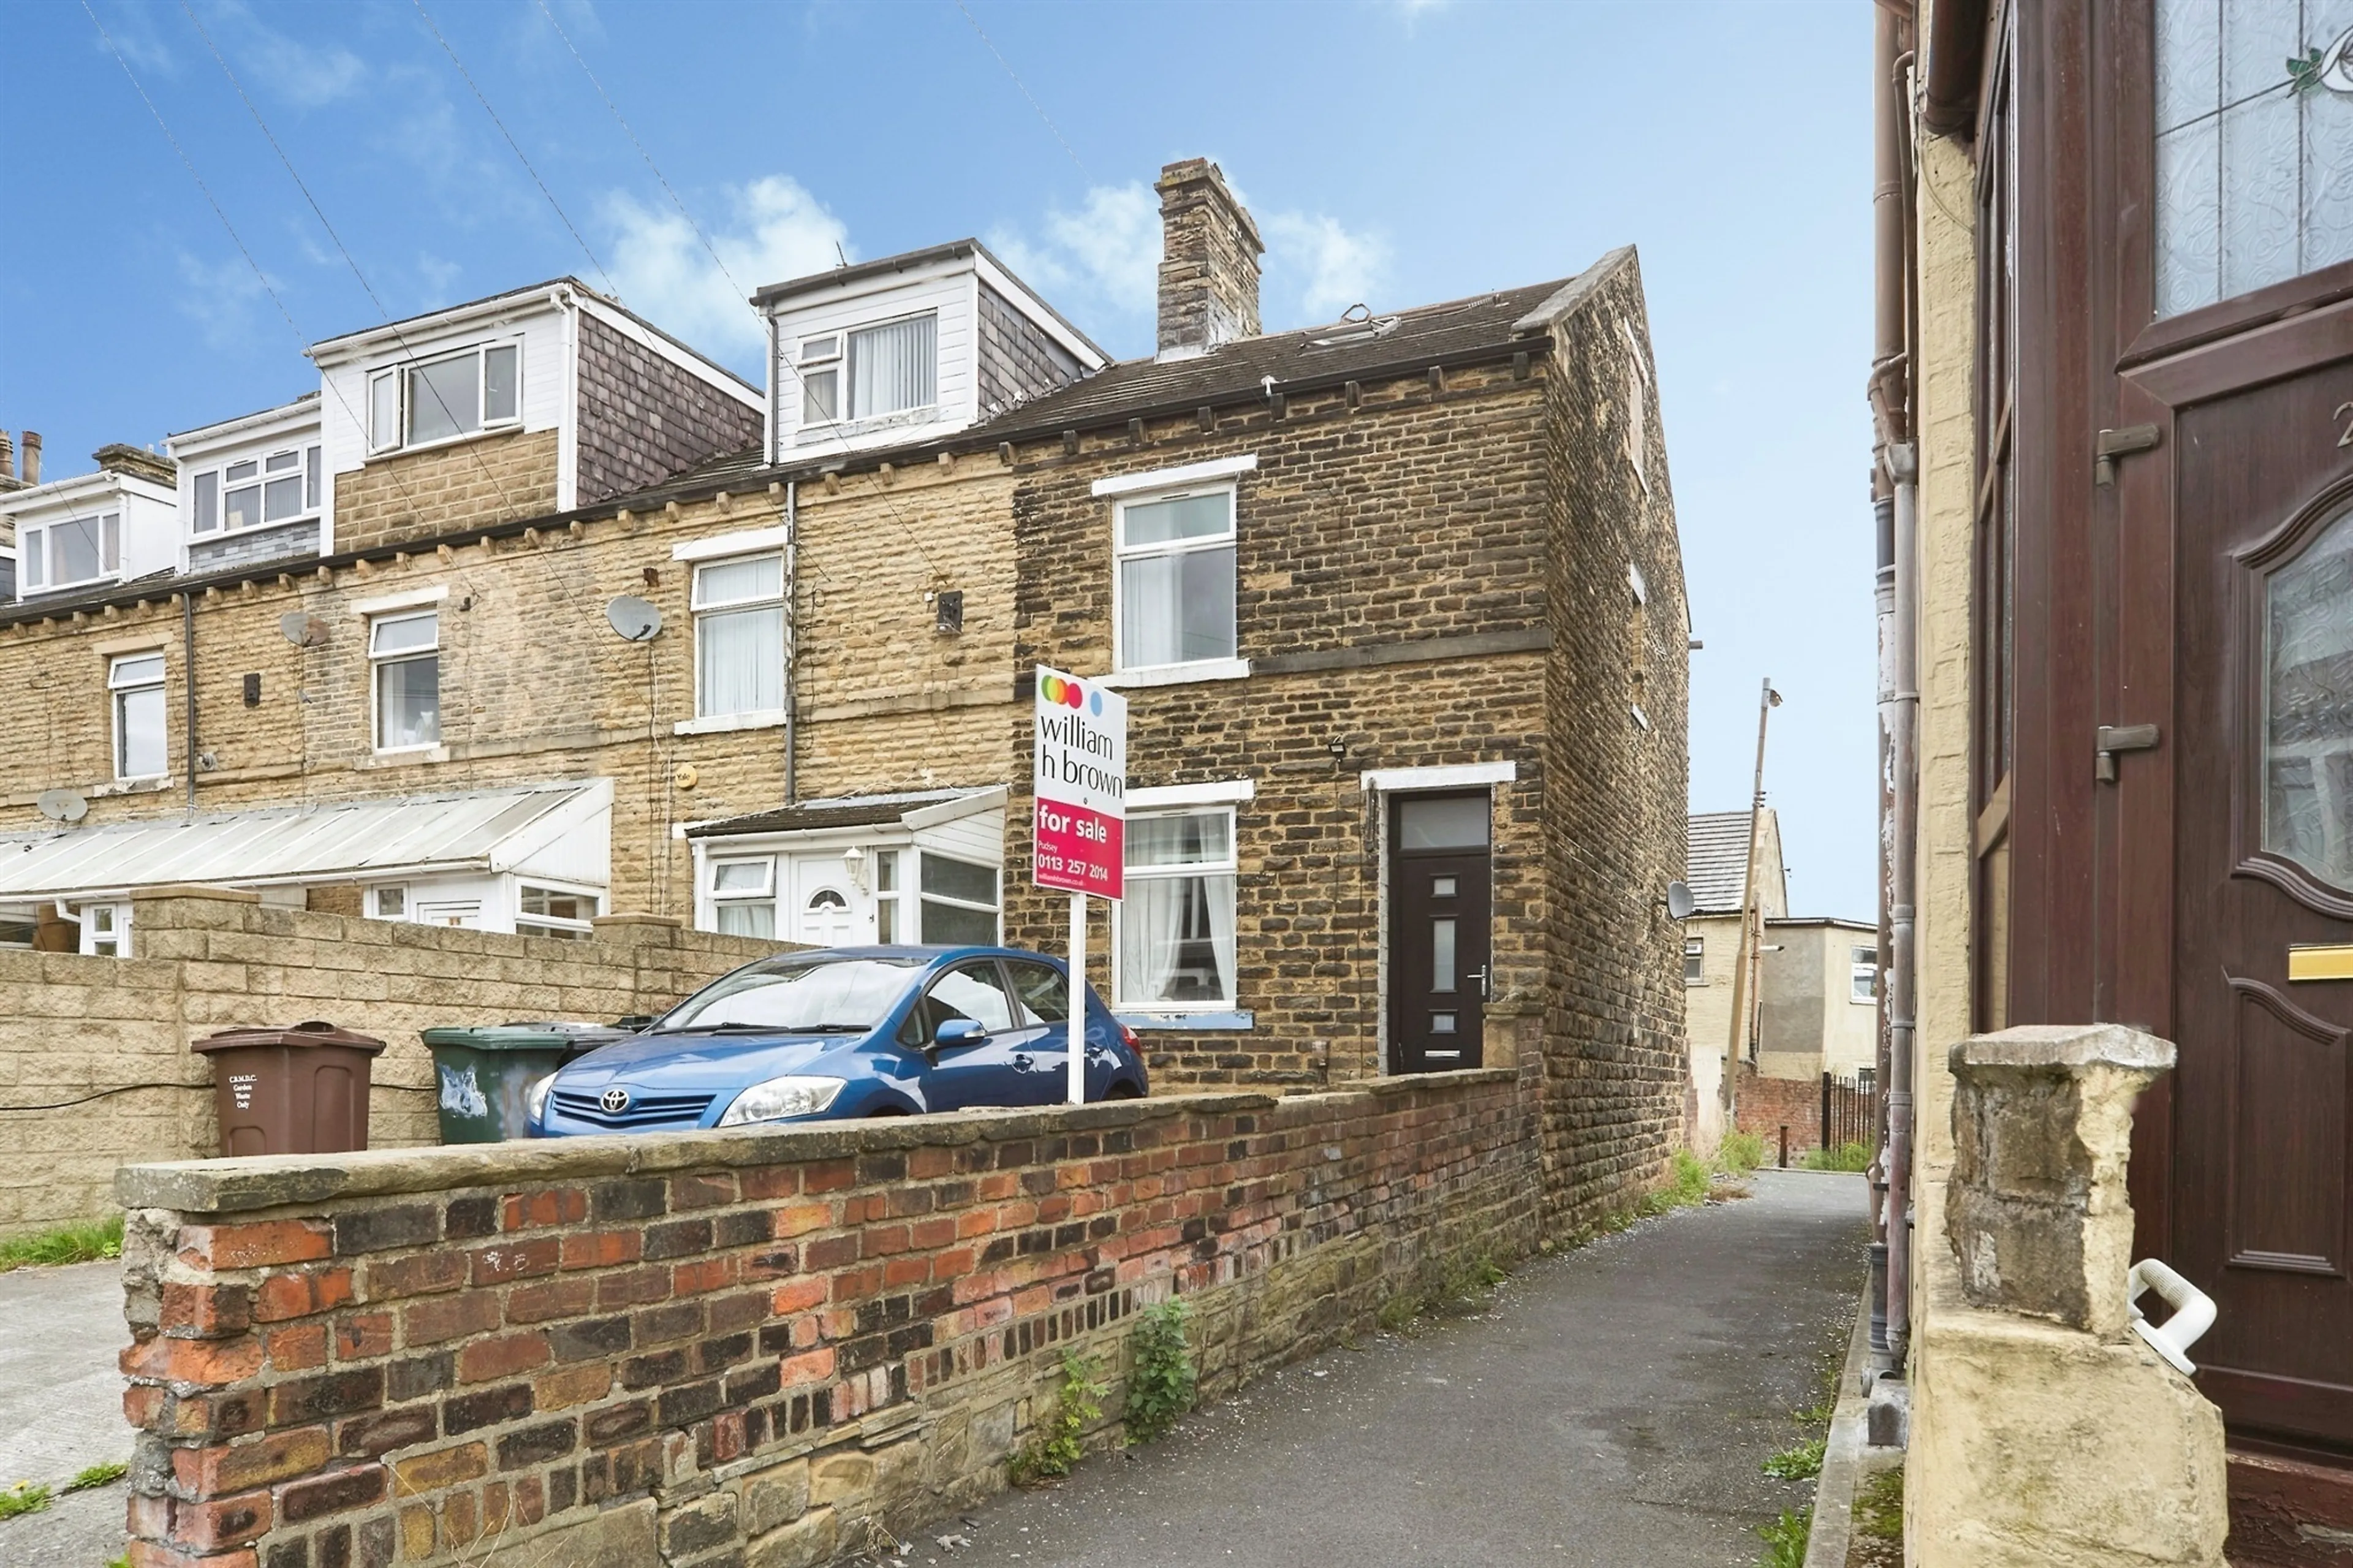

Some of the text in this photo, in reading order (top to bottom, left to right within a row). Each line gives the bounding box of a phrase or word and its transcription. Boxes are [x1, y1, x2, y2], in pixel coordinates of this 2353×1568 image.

[1040, 714, 1113, 760] william
[1042, 743, 1123, 799] h brown
[1039, 804, 1107, 844] for sale
[1038, 839, 1058, 854] Pudsey
[1038, 854, 1108, 882] 0113 257 2014
